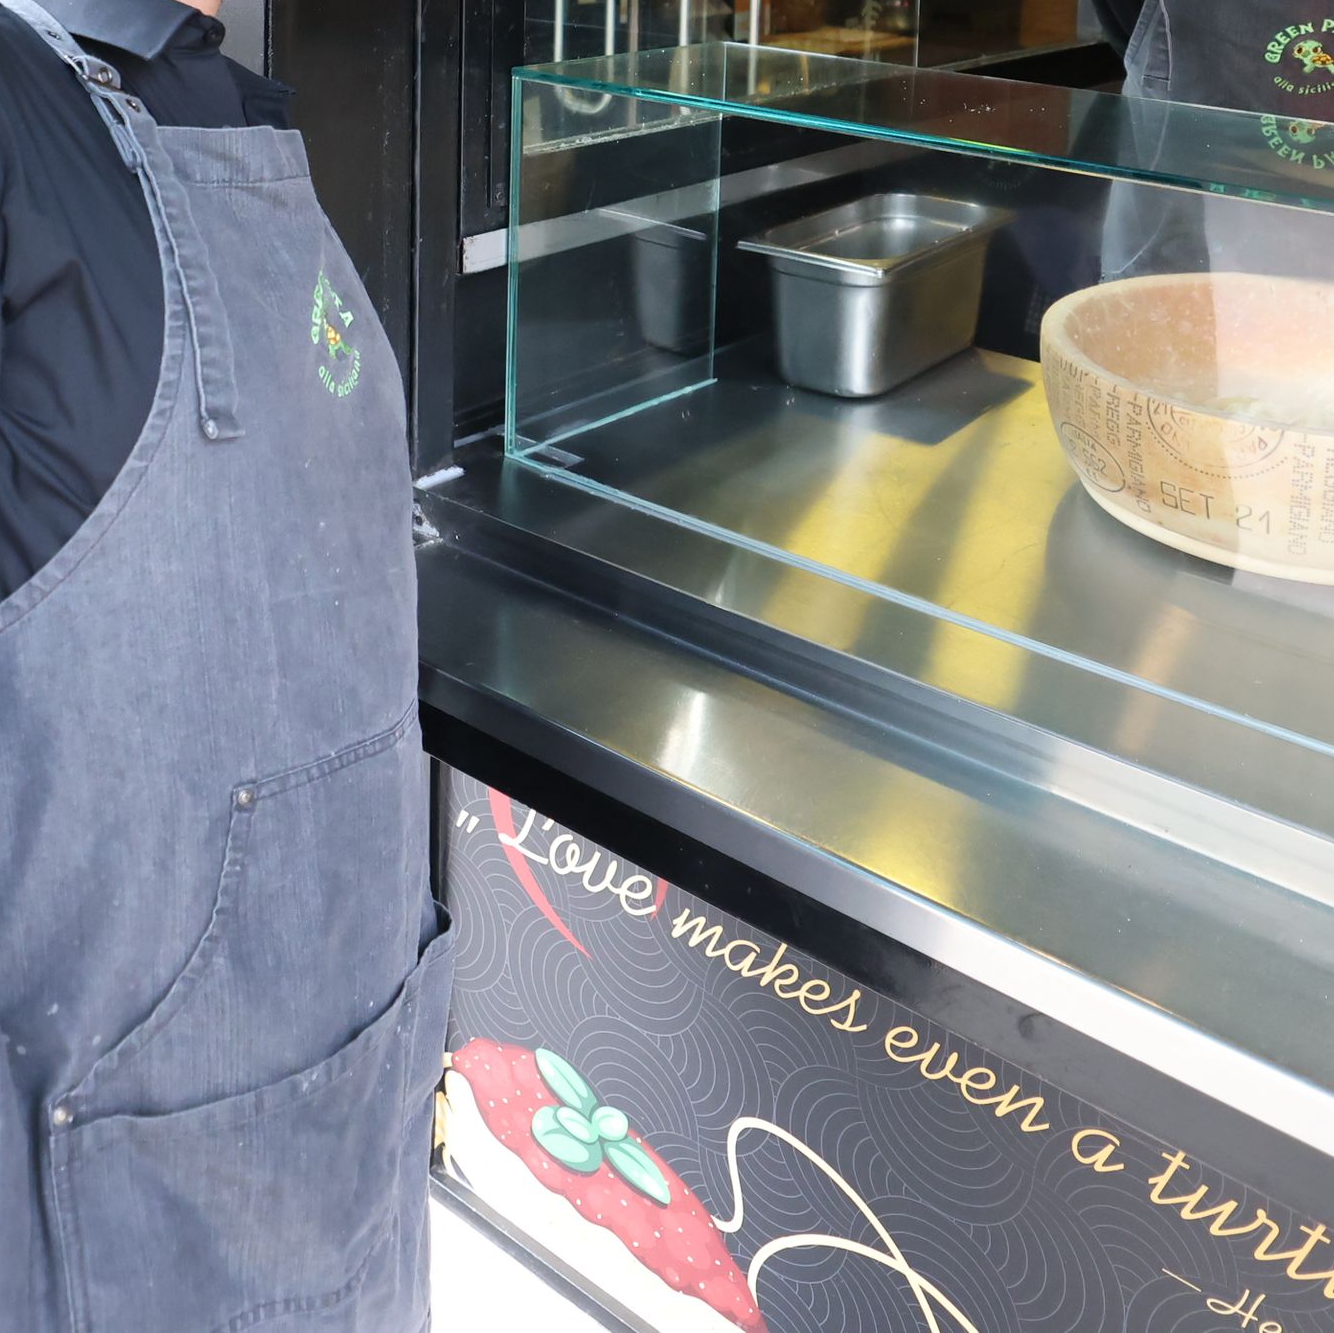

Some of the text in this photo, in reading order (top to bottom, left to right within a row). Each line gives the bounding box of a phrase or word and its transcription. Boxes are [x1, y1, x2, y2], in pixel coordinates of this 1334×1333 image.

[1265, 22, 1314, 63] GREEN
[1273, 76, 1295, 92] alla
[1160, 480, 1214, 520] SET
[1236, 505, 1271, 534] 21
[671, 906, 866, 1033] makes
[883, 1024, 1050, 1133] even
[1071, 1127, 1125, 1173] a
